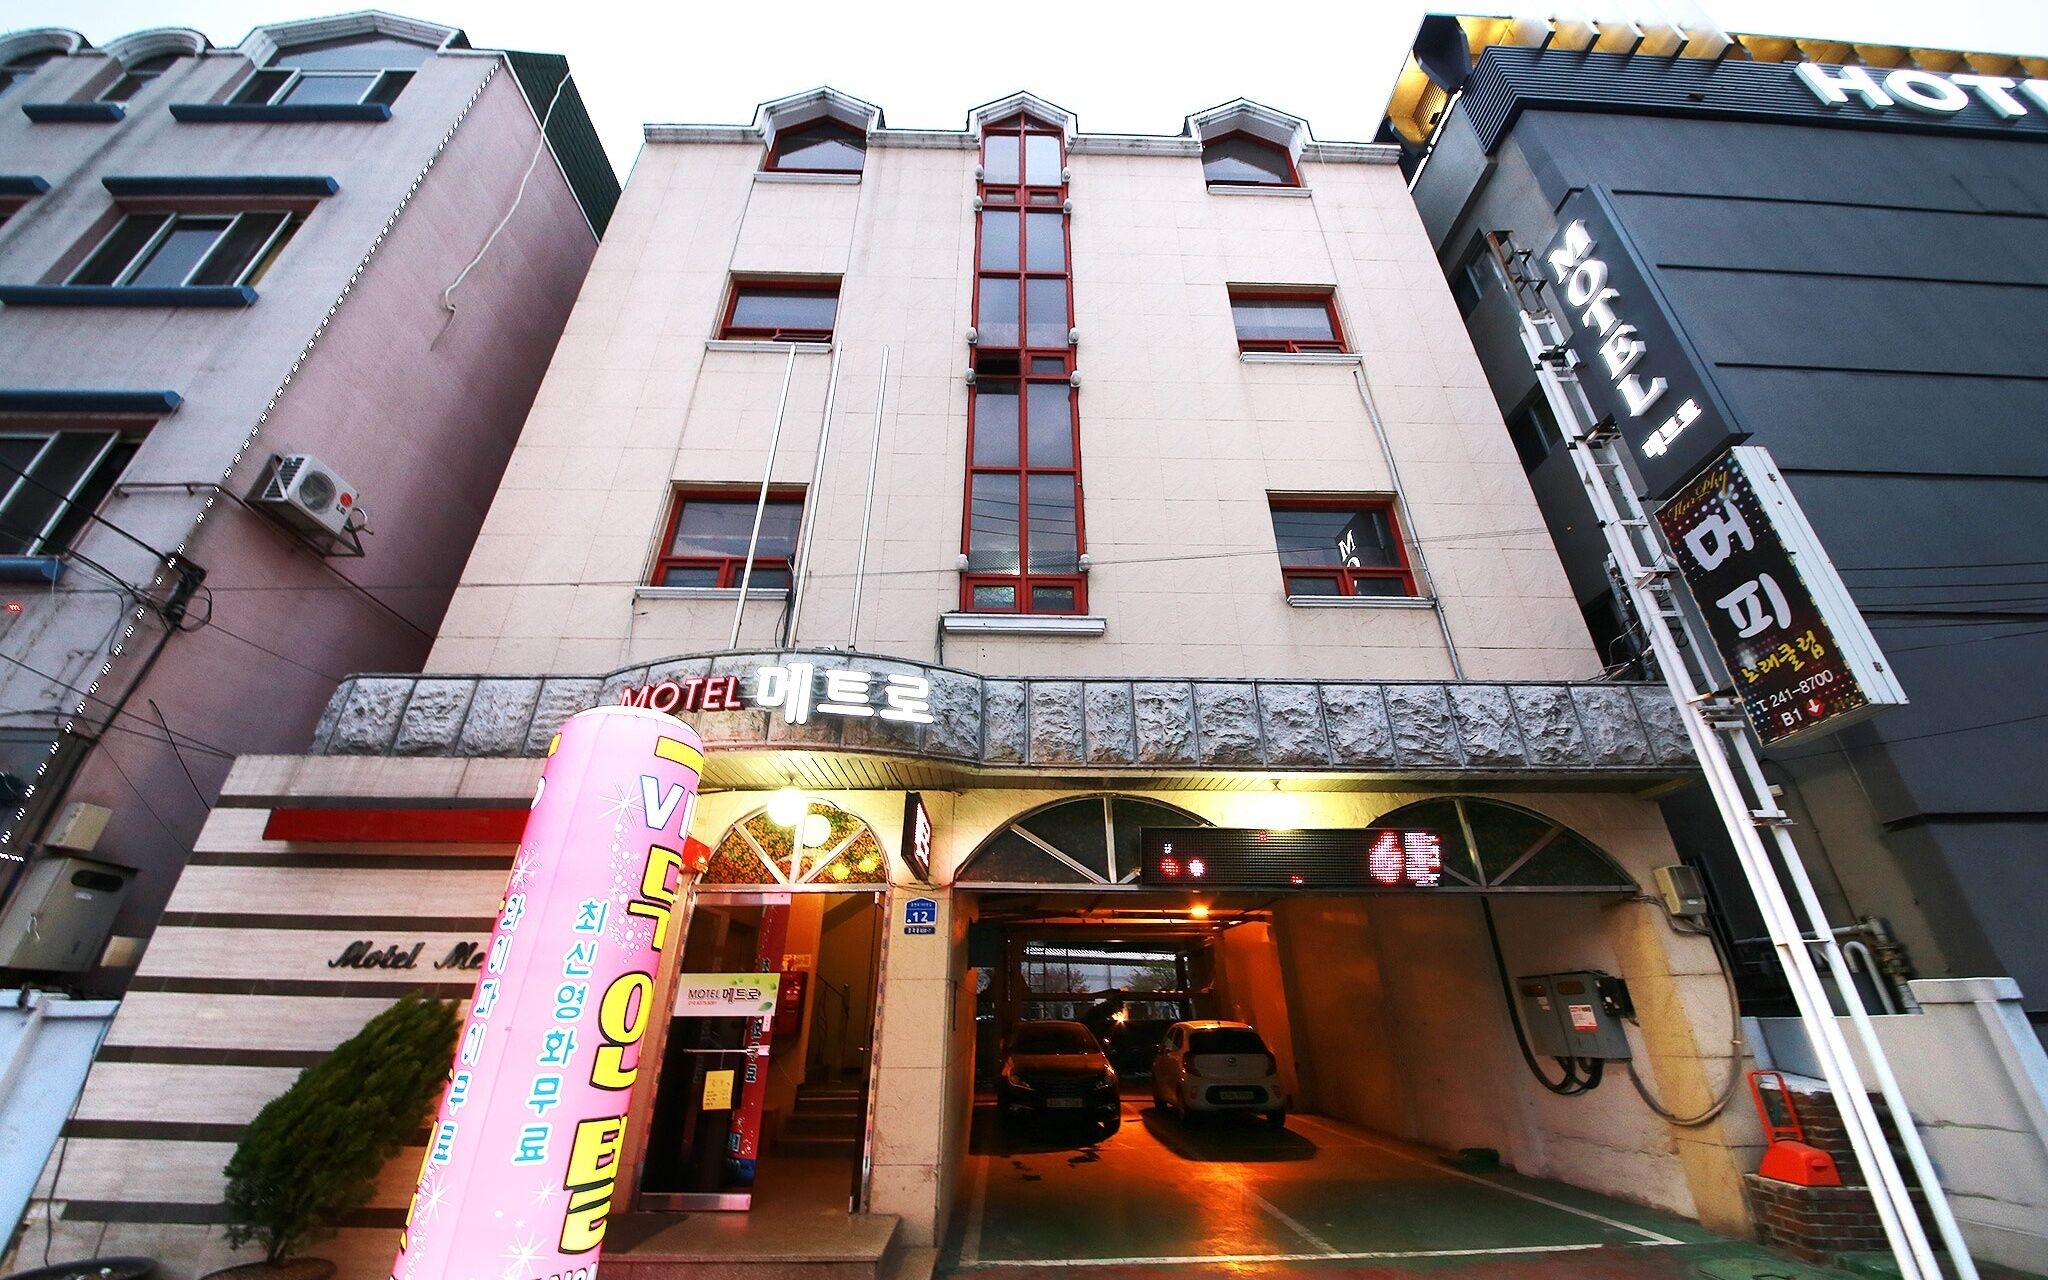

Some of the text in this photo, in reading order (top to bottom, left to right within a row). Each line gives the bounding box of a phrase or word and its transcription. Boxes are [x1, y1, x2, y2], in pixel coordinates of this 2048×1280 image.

[1546, 217, 1668, 418] MOTEL
[1741, 629, 1826, 685] 노래클럽
[620, 675, 744, 713] MOTEL
[755, 661, 935, 726] 메트로
[1769, 669, 1834, 708] 241-8700
[1781, 708, 1803, 728] B1
[912, 911, 929, 923] 12
[328, 940, 426, 970] Motel
[688, 989, 720, 999] MOTEL
[722, 987, 762, 1004] 메트로
